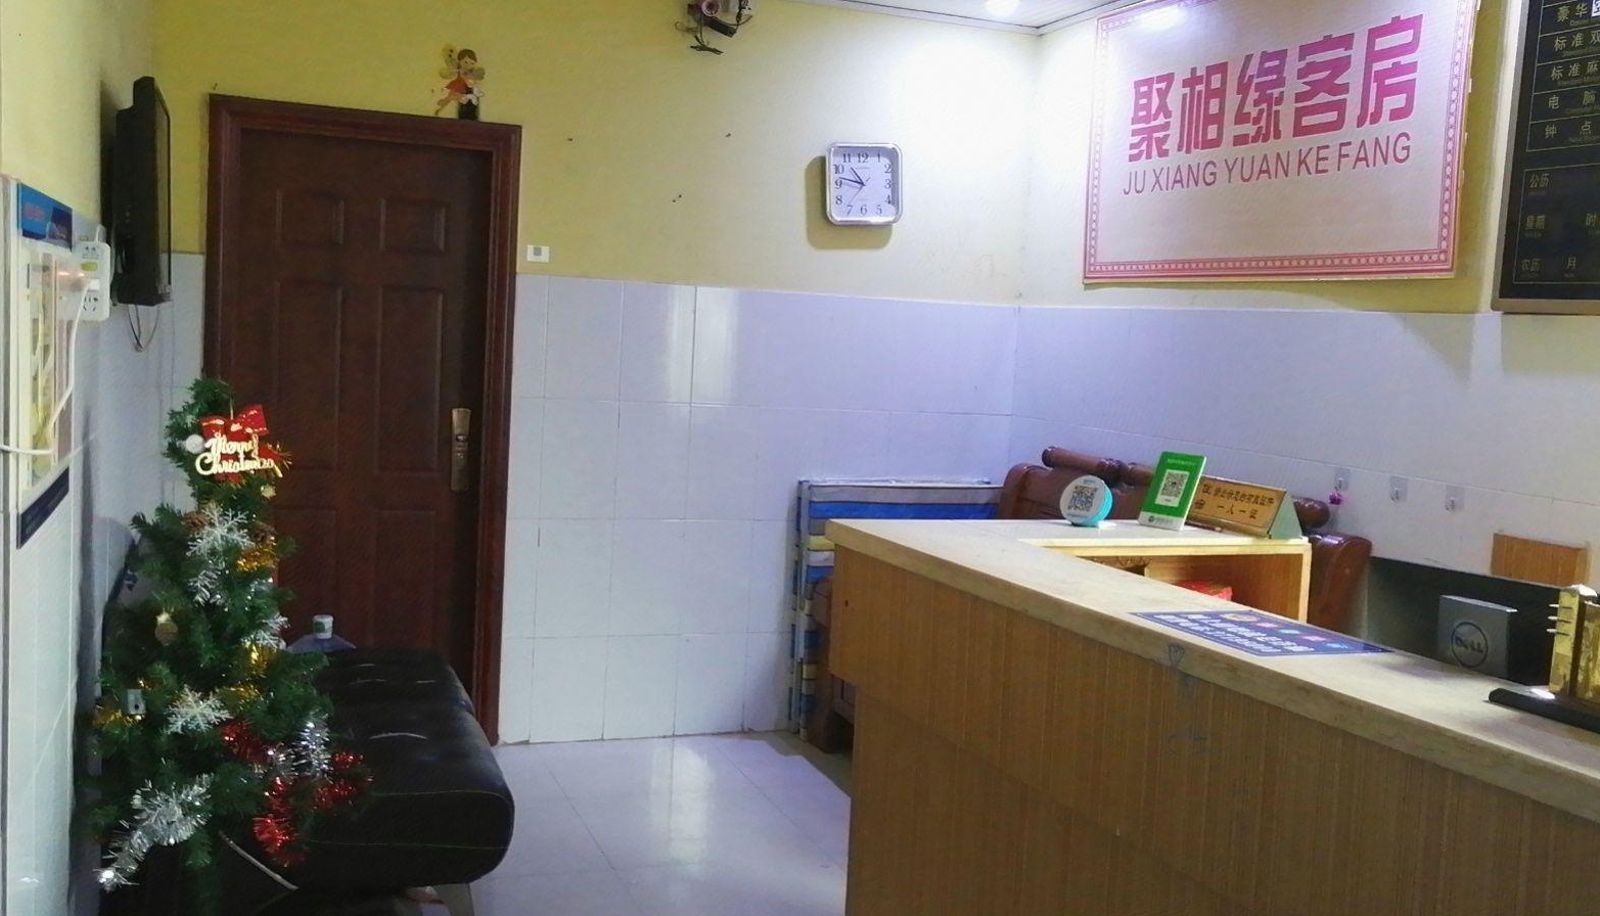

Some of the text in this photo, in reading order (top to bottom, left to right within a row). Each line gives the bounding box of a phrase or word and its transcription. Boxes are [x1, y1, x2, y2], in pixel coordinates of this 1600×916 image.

[1128, 14, 1424, 163] 聚相缘客房
[843, 152, 852, 163] 11
[857, 152, 869, 163] 12
[833, 164, 845, 174] 10
[884, 163, 892, 174] 2
[1123, 132, 1411, 195] JU XIANG YUAN KE FANG
[834, 180, 843, 190] 9
[884, 179, 892, 189] 3
[835, 195, 843, 205] 8
[846, 205, 853, 216] 7
[860, 205, 868, 215] 6
[875, 204, 882, 215] 5
